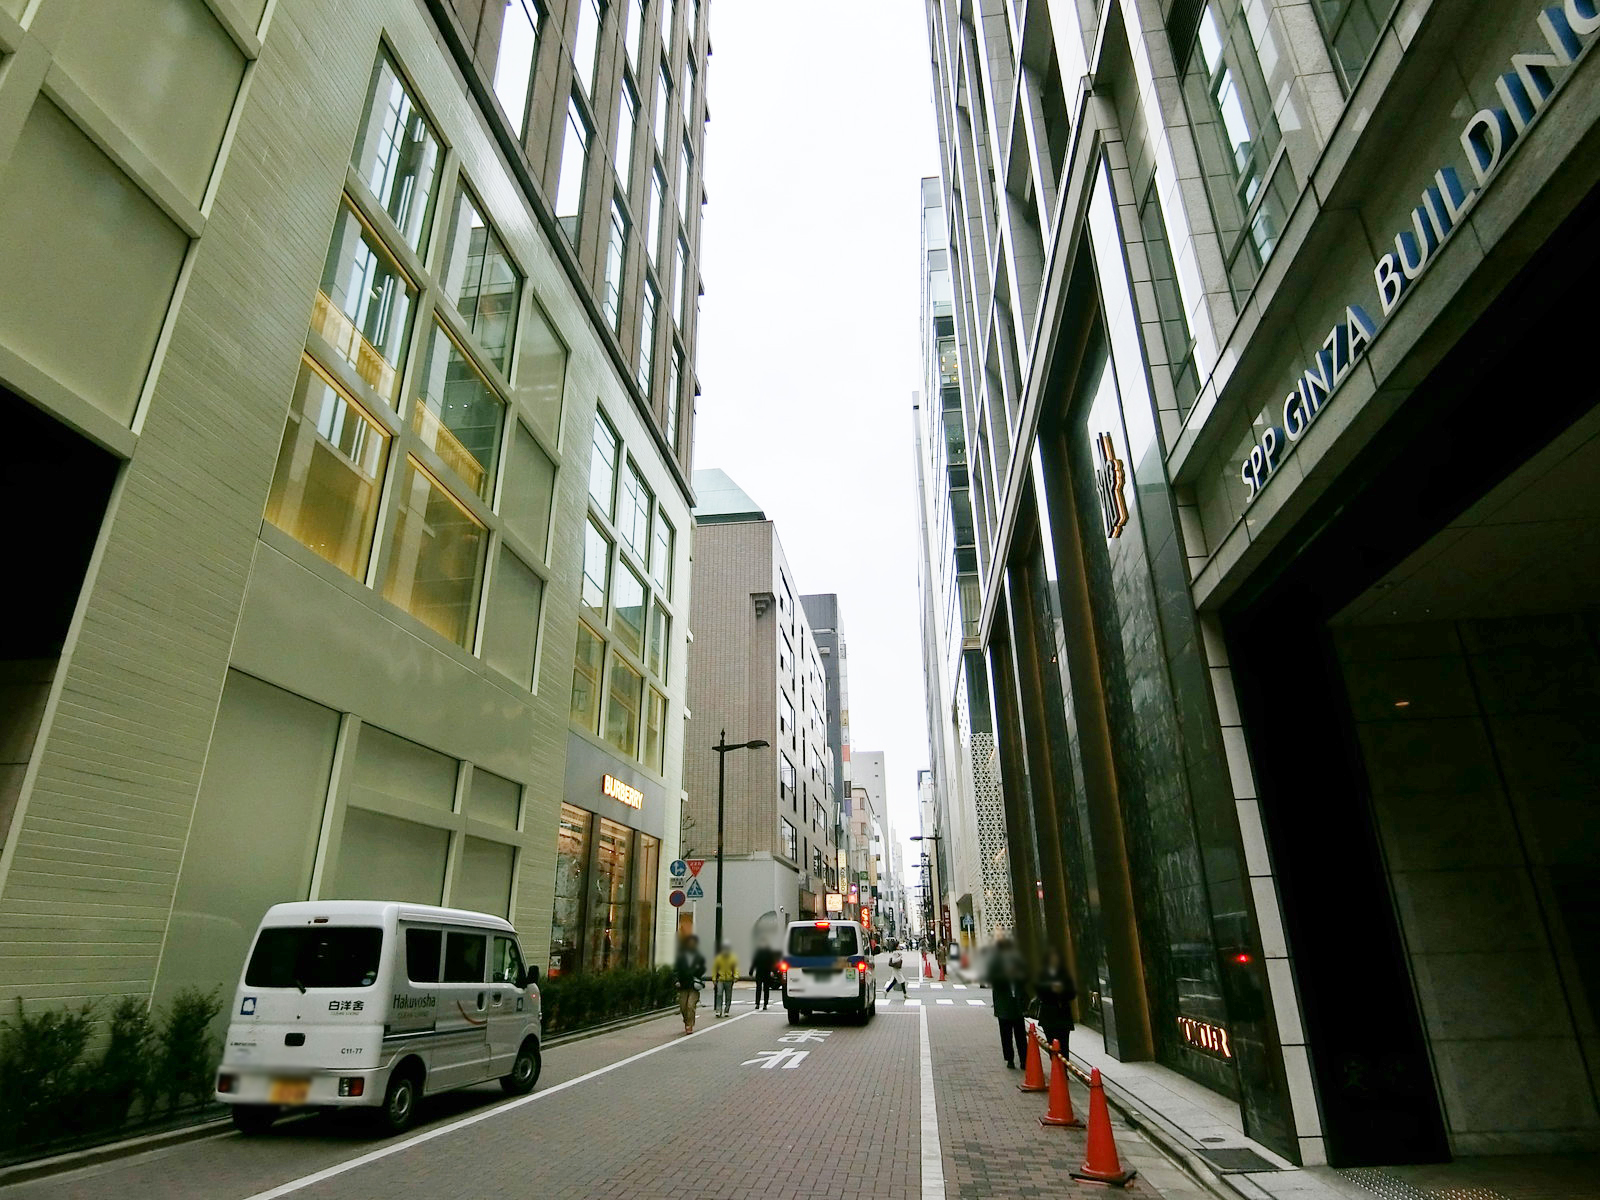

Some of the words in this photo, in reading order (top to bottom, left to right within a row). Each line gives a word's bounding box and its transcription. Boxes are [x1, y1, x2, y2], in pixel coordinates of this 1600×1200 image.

[1241, 427, 1280, 504] SPP
[1283, 305, 1373, 442] GINZA
[603, 774, 644, 810] BURBERRY
[341, 1047, 363, 1055] C11-77
